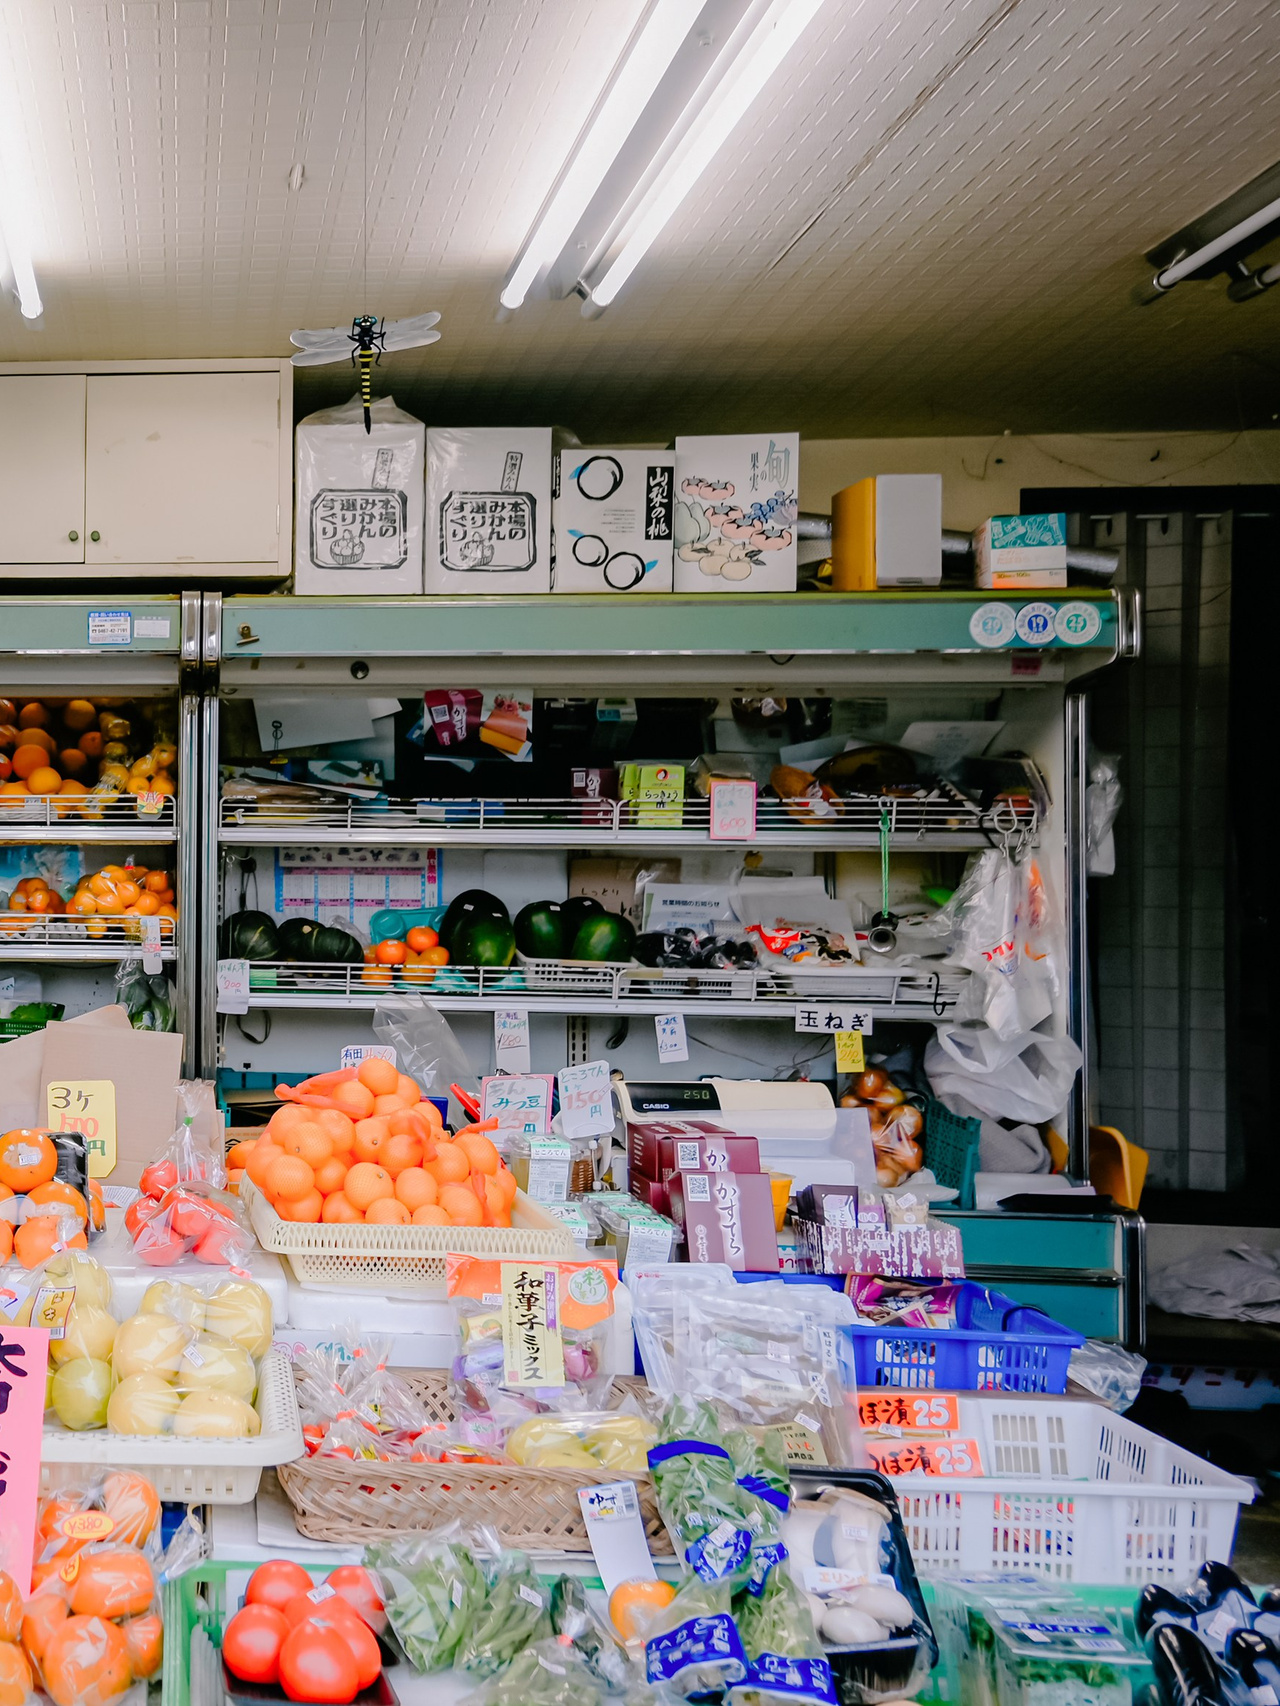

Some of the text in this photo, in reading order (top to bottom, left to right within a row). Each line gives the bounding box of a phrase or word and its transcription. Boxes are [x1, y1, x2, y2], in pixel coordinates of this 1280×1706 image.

[646, 467, 671, 541] 山梨の桃
[359, 498, 377, 538] みかん
[488, 501, 506, 541] みかん
[645, 791, 679, 801] らっきょう
[799, 1010, 869, 1032] 玉ねぎ
[560, 1065, 608, 1083] ところてん
[491, 1095, 547, 1110] みつ豆
[683, 1090, 710, 1100] 250
[590, 1105, 603, 1118] 円
[633, 1226, 668, 1237] ところてん
[716, 1183, 742, 1256] かすてら
[513, 1271, 544, 1381] 和菓子ミックス
[912, 1397, 950, 1426] 25
[934, 1443, 973, 1474] 25
